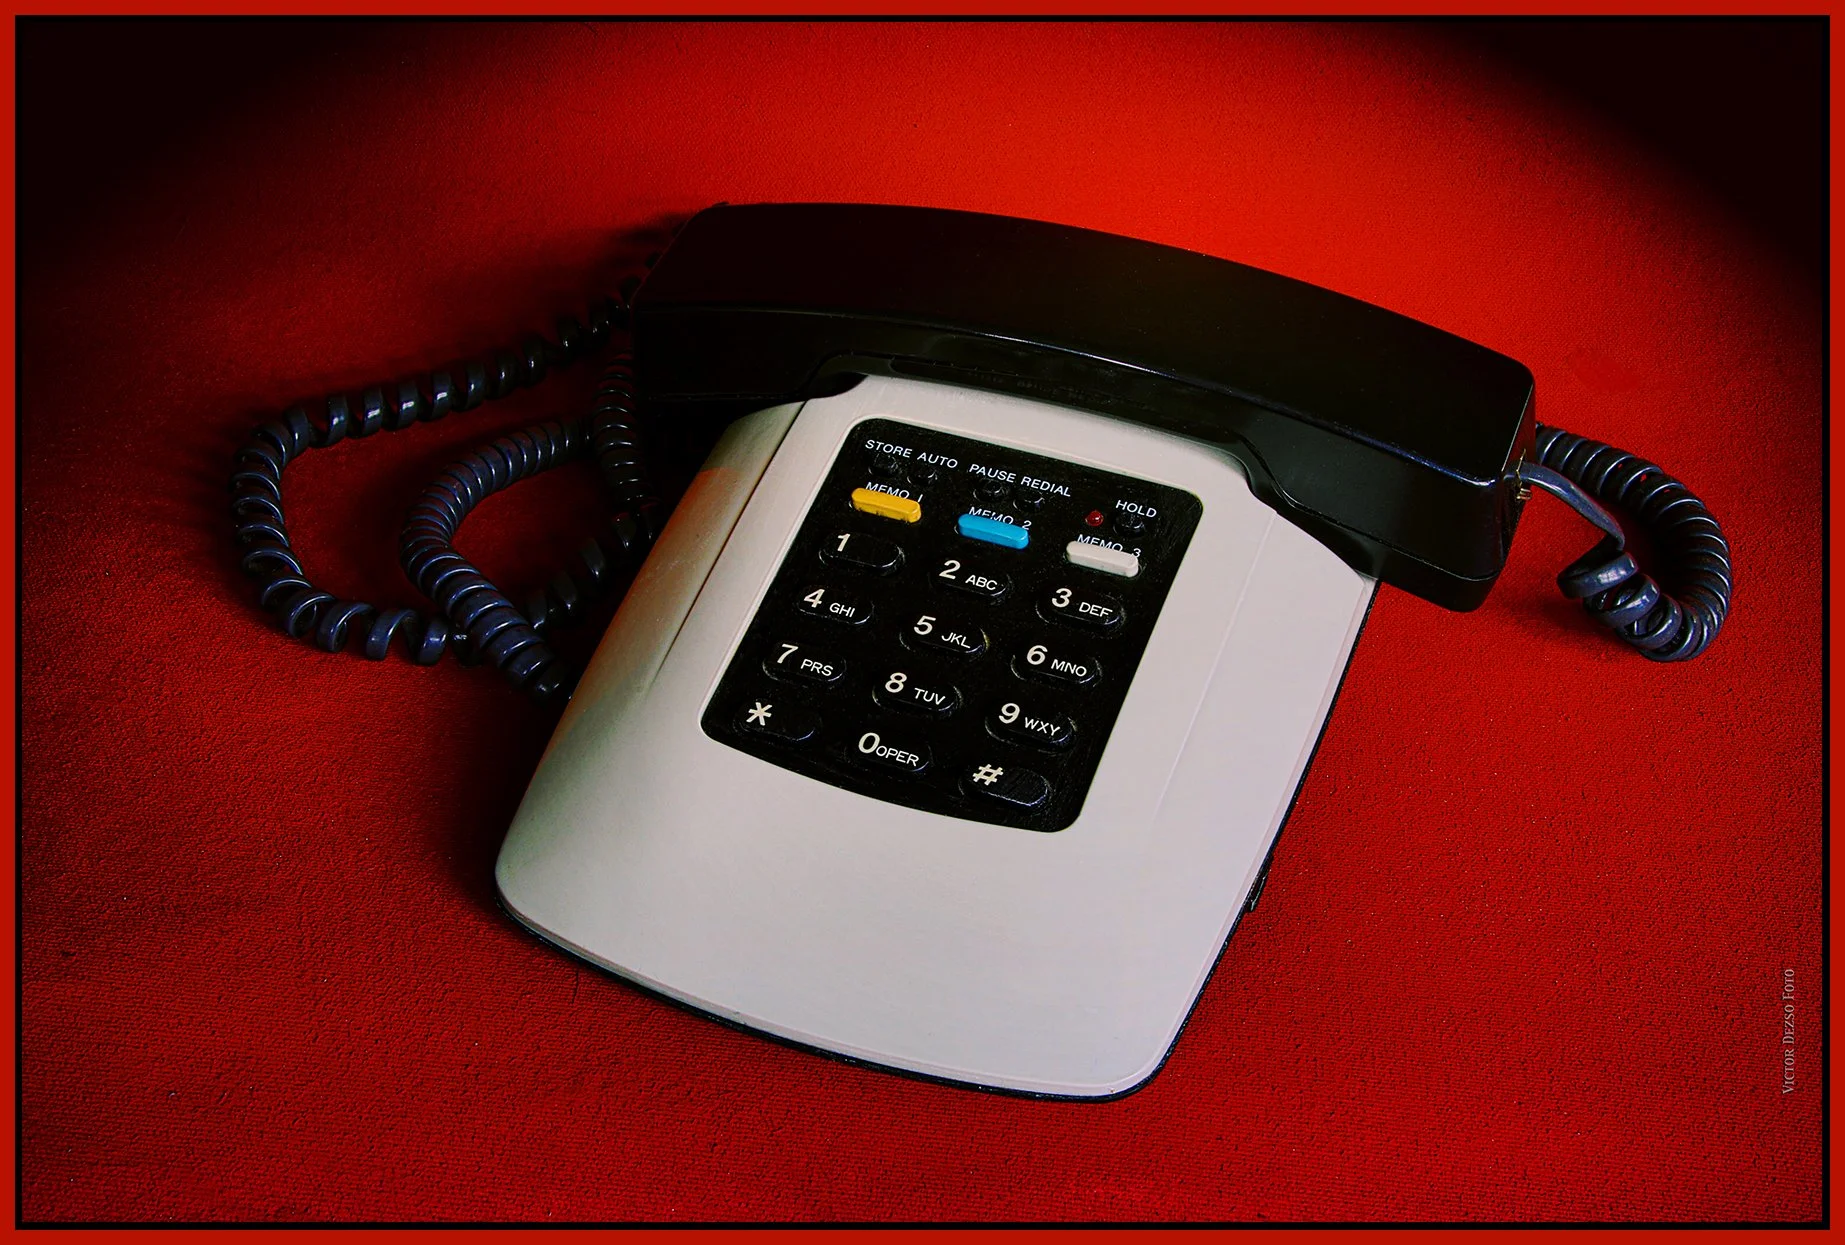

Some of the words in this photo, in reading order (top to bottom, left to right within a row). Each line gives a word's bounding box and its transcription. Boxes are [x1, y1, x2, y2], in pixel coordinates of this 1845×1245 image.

[864, 439, 913, 458] STORE
[916, 452, 958, 469] AUTO
[865, 481, 910, 499] MEMO
[968, 463, 1017, 483] PAUSE
[1020, 476, 1071, 497] REDIAL
[968, 506, 1014, 525] MEMO
[1021, 520, 1032, 530] 2
[1115, 499, 1157, 518] HOLD
[837, 533, 851, 552] 1
[1077, 533, 1123, 551] MEMO
[1131, 547, 1142, 558] 3
[938, 559, 961, 580] 2
[965, 574, 998, 591] ABC
[803, 588, 825, 608] 4
[829, 602, 856, 618] GHI
[1051, 587, 1073, 608] 3
[1078, 601, 1113, 618] DEF
[913, 615, 937, 636] 5
[941, 632, 971, 649] JKL
[776, 643, 799, 664] 7
[800, 658, 834, 677] PRS
[1026, 644, 1048, 666] 6
[1050, 658, 1087, 677] MNO
[884, 672, 908, 694] 8
[913, 687, 946, 706] TUV
[998, 702, 1021, 724] 9
[1024, 716, 1061, 737] WXY
[858, 732, 881, 754] 0
[875, 745, 920, 767] OPER
[972, 763, 1004, 786] #
